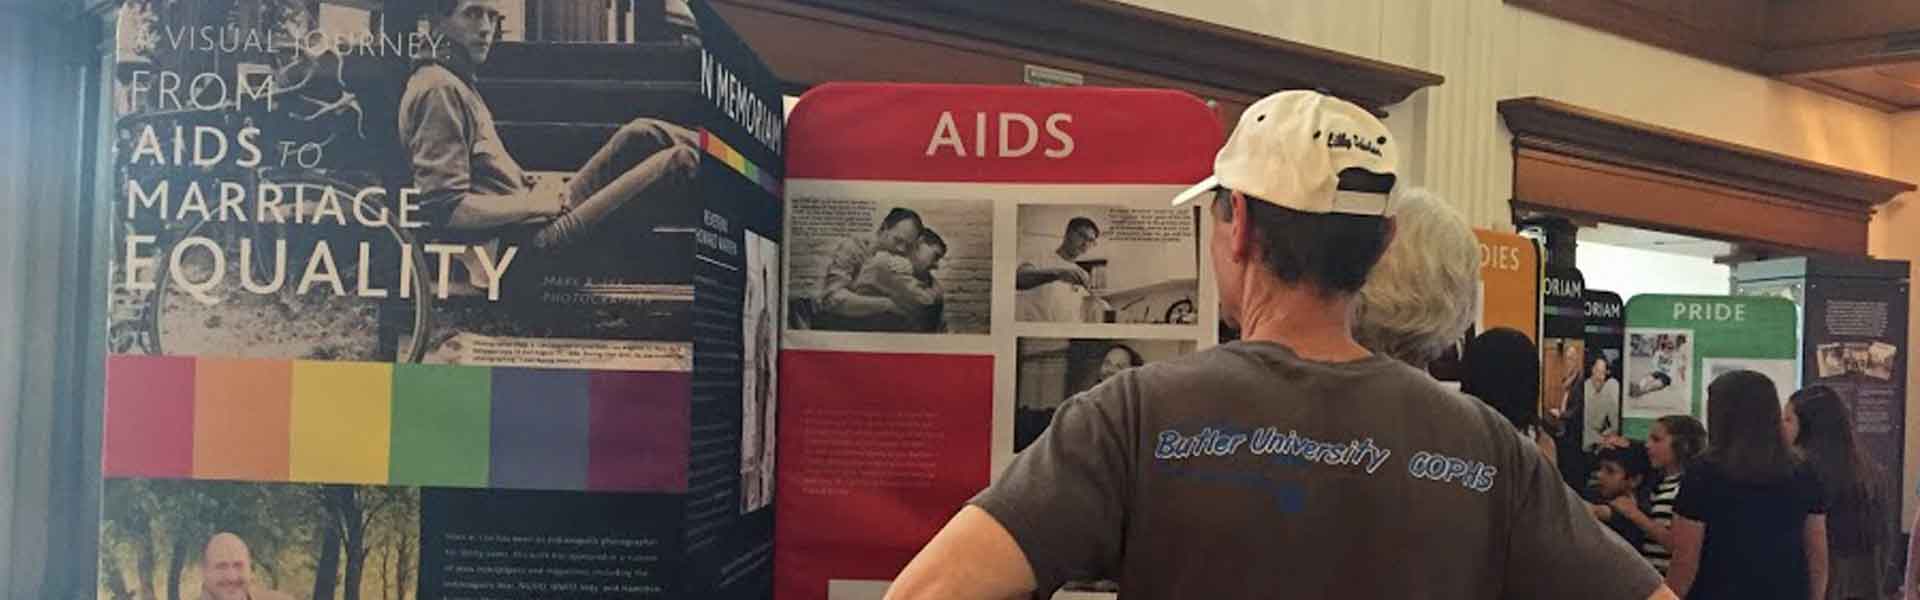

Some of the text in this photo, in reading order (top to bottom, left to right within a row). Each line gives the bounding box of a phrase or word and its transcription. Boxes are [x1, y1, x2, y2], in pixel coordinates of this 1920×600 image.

[165, 25, 276, 53] VISUAL
[288, 31, 451, 59] JOURNEY:
[131, 69, 273, 112] FROM
[130, 125, 324, 169] AIDS TO
[926, 111, 1075, 158] AIDS
[126, 178, 430, 229] MARRIAGE
[125, 233, 519, 303] EQUALITY
[1672, 302, 1748, 321] PRIDE
[1155, 427, 1498, 492] Butler University COPHS
